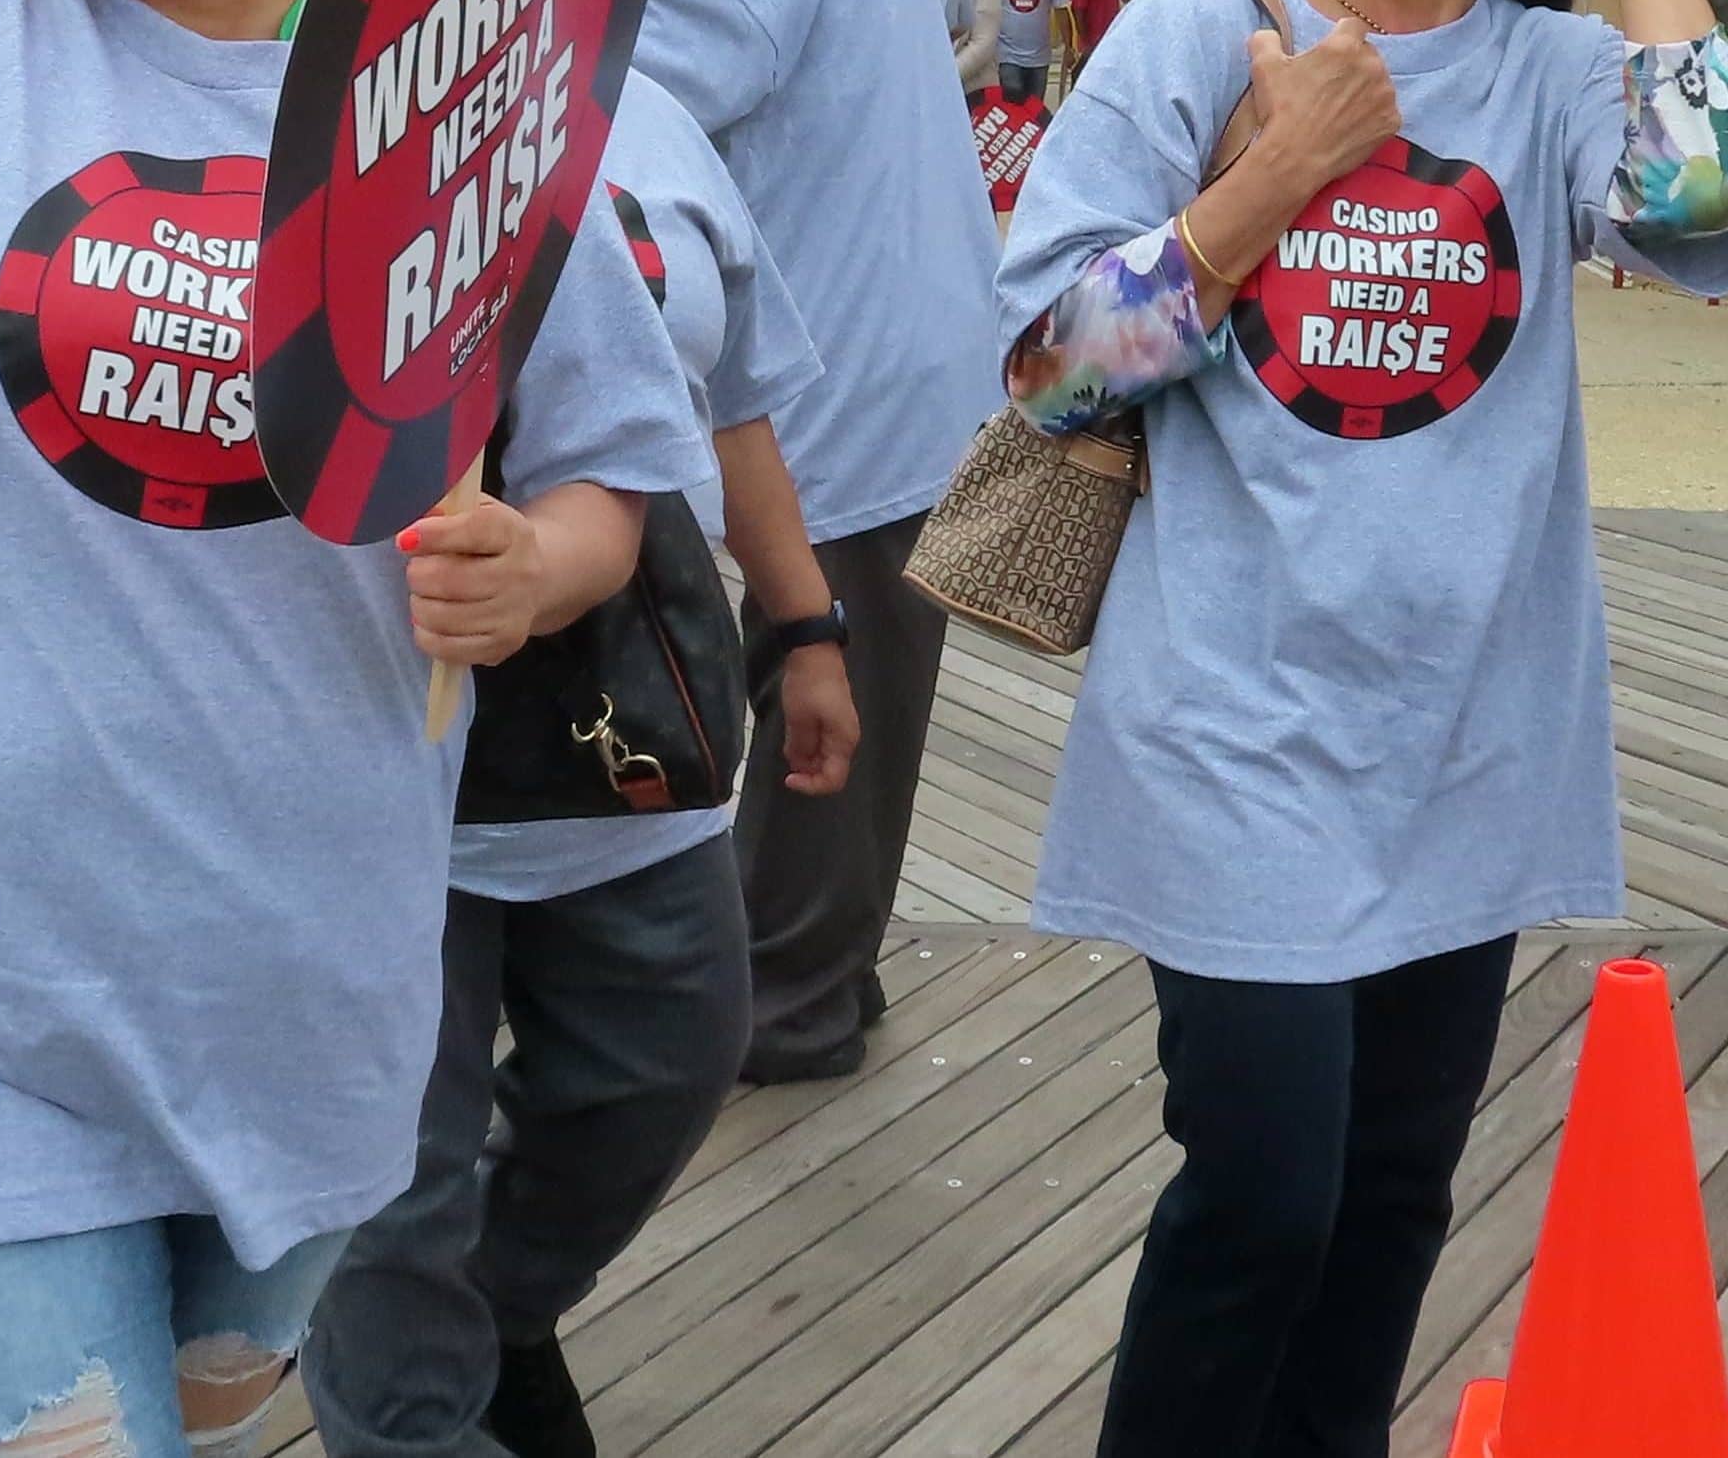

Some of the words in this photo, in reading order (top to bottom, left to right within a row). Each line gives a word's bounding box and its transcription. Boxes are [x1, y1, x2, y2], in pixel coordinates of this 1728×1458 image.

[428, 32, 529, 197] NEED
[382, 41, 574, 383] RAI$E
[1331, 197, 1440, 236] CASINO
[151, 218, 259, 270] CASIN
[1276, 229, 1488, 285] WORKERS
[72, 236, 254, 322] WORK
[1329, 278, 1405, 313] NEED
[1408, 287, 1430, 316] A
[131, 305, 243, 363] NEED
[1298, 314, 1451, 377] RAI$E
[79, 348, 256, 449] RAI$
